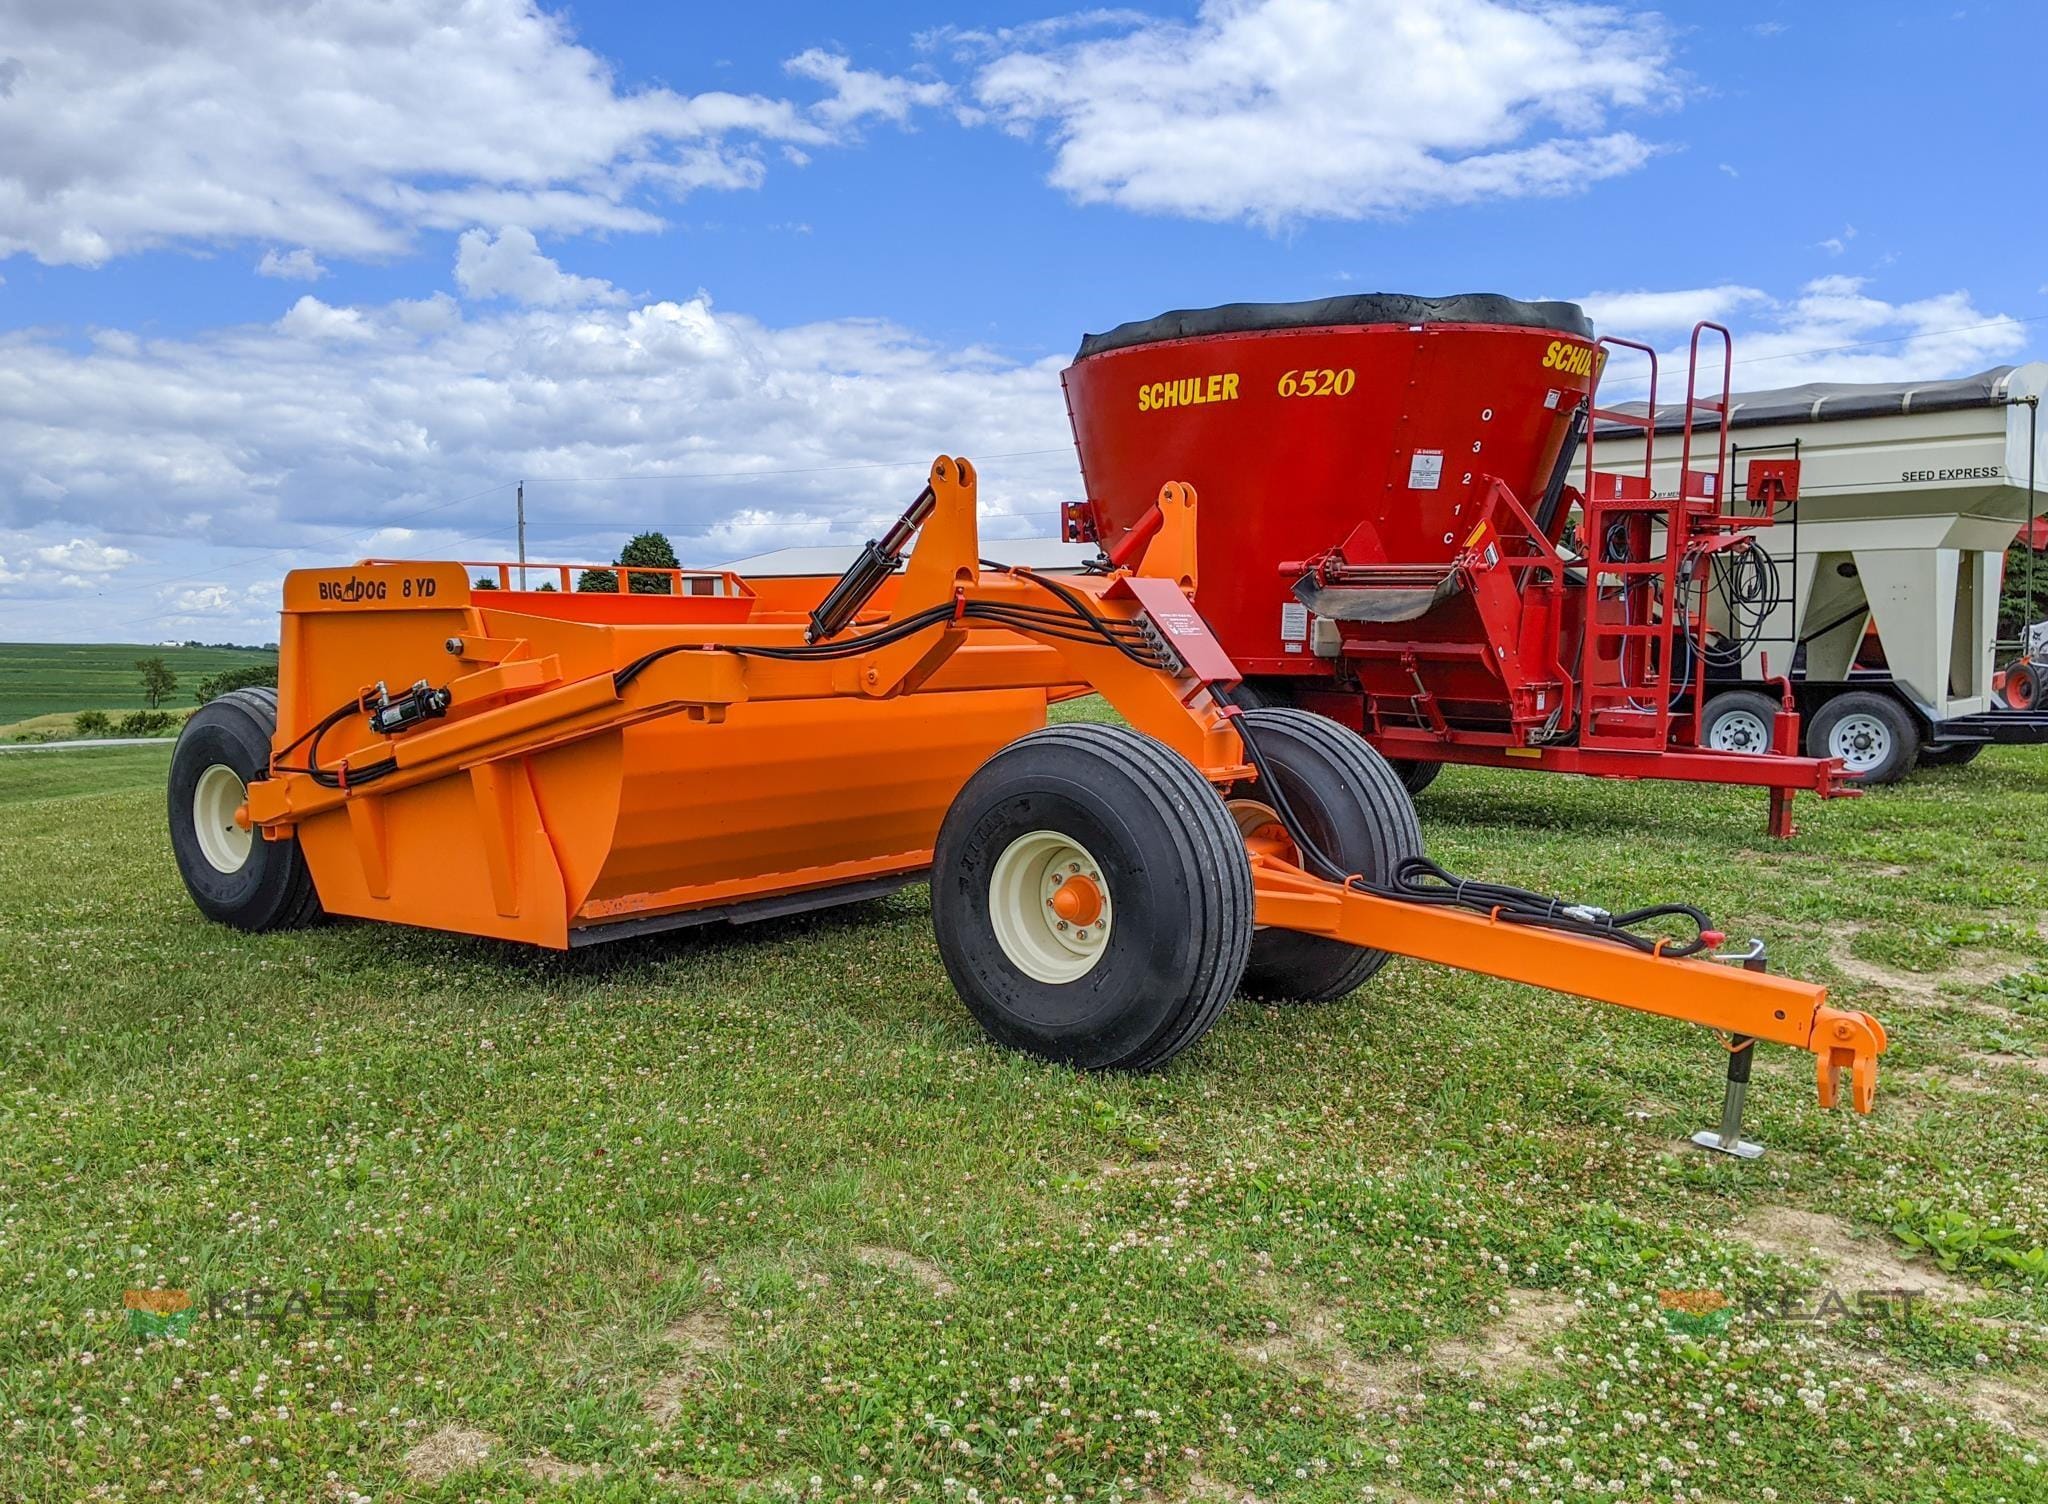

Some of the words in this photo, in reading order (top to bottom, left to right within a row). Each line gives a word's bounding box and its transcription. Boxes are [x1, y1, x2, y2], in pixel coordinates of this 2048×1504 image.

[1138, 373, 1240, 412] SCHULER
[1277, 368, 1356, 398] 6520
[1472, 440, 1482, 453] 3
[1461, 472, 1472, 485] 2
[1901, 470, 1935, 482] SEED
[1938, 466, 1998, 480] EXPRESS
[1454, 503, 1461, 516] 1
[1443, 532, 1454, 544] C
[319, 582, 342, 600] BIG
[356, 581, 387, 600] DOG
[402, 579, 411, 598] 8
[416, 578, 436, 597] YD
